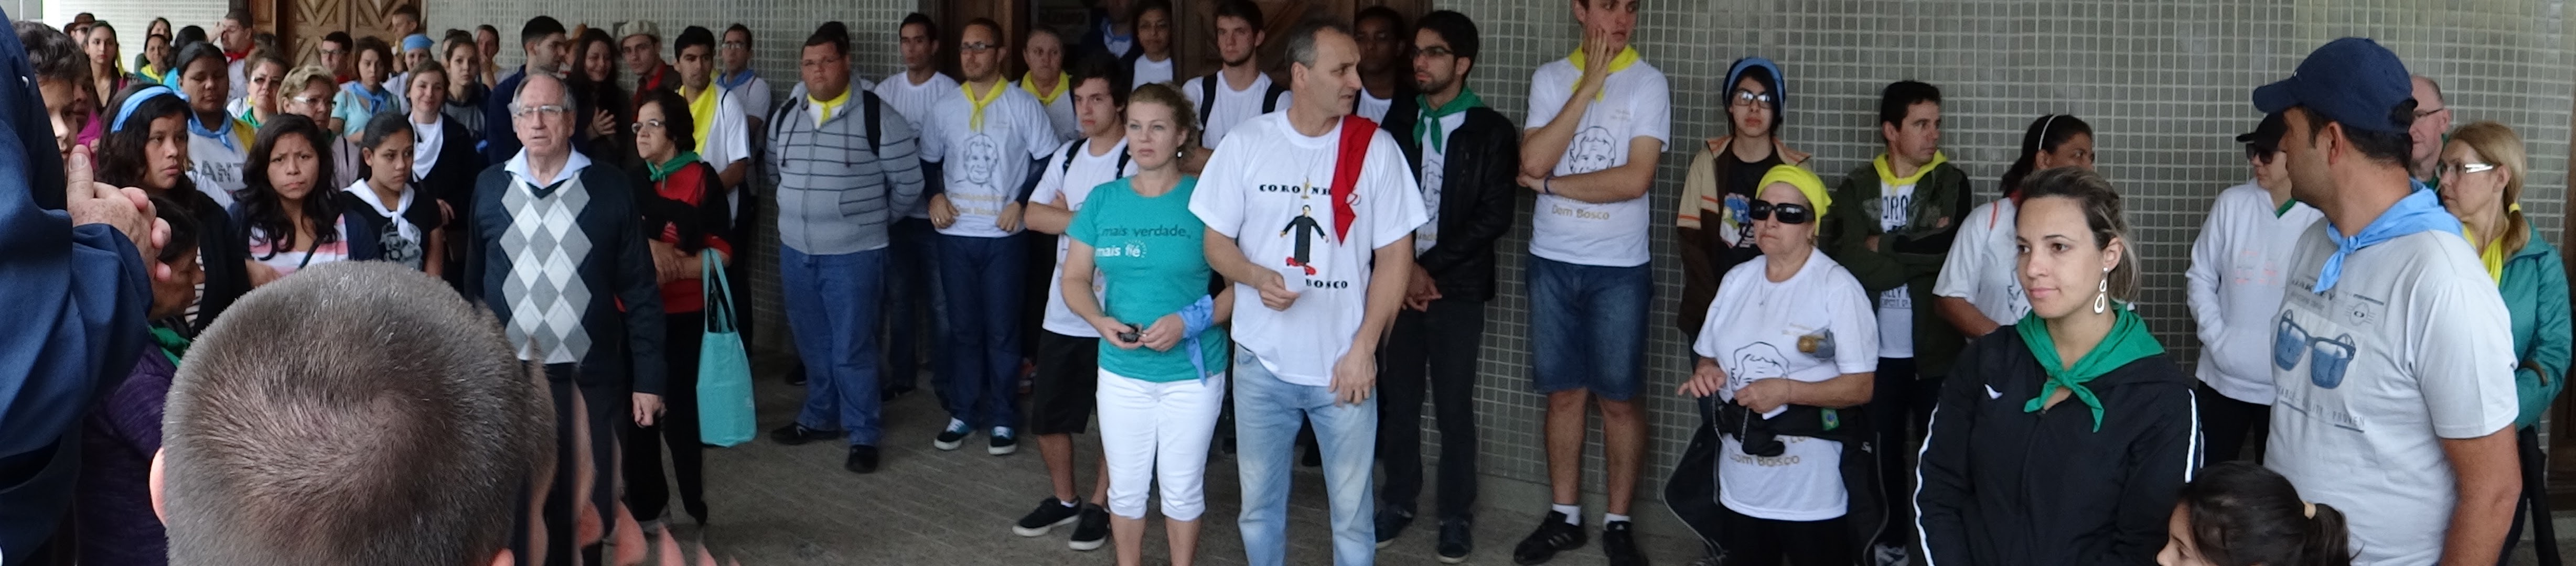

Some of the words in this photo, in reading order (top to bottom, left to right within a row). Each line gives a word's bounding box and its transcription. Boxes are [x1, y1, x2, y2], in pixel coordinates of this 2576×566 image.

[1102, 225, 1128, 236] mais
[1094, 245, 1121, 257] mais
[1305, 279, 1348, 289] BOSCO
[1758, 455, 1800, 466] Bosco
